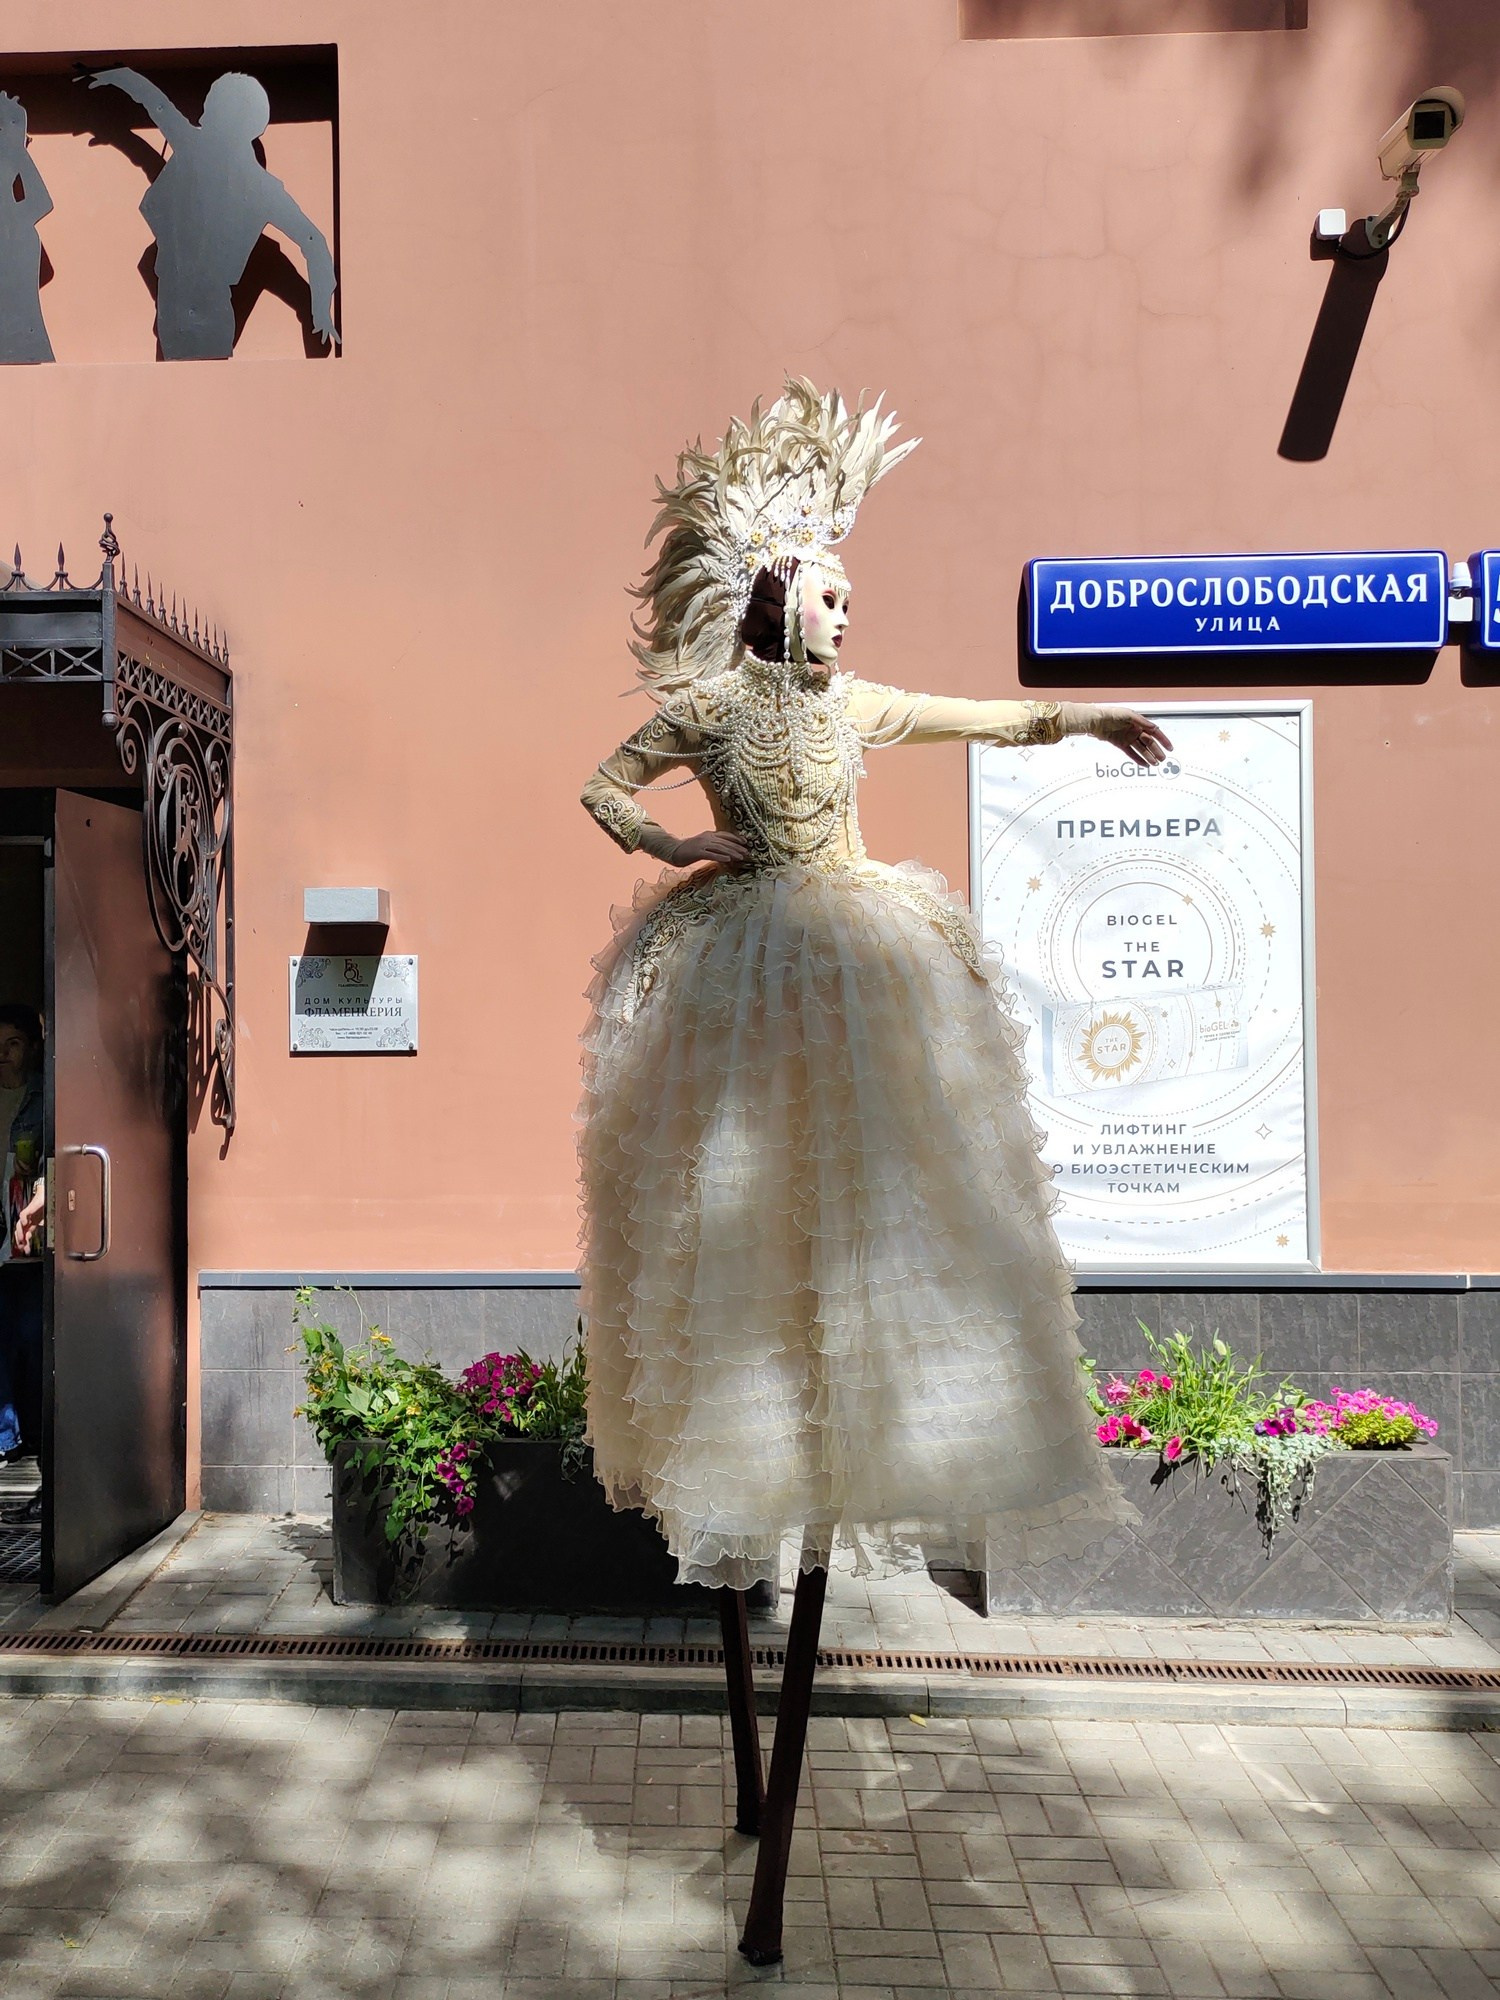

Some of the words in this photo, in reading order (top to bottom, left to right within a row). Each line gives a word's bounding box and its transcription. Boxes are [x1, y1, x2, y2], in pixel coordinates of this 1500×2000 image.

[1050, 573, 1428, 614] ДОБРОСЛОБОДСКАЯ
[1195, 616, 1281, 632] УЛИЦА
[1096, 761, 1157, 778] bioGEL
[1057, 818, 1222, 839] ПРЕМЬЕРА
[1107, 914, 1178, 926] BIOGEL
[1123, 941, 1160, 953] THE
[1101, 959, 1184, 979] STAR
[304, 997, 330, 1006] ДОМ
[338, 996, 403, 1005] КУЛЬТУРЫ
[304, 1006, 402, 1018] ФЛАМЕНКЕРИЯ
[1199, 1020, 1229, 1034] bioGEL
[1096, 1042, 1127, 1055] STAR
[1100, 1123, 1187, 1136] ЛИФТИНГ
[1073, 1144, 1084, 1155] И
[1091, 1143, 1216, 1155] УВЛАЖНЕНИЕ
[1071, 1162, 1249, 1175] БИОЭСТЕТИЧЕСКИМ
[1107, 1182, 1180, 1194] ТОЧКАМ
